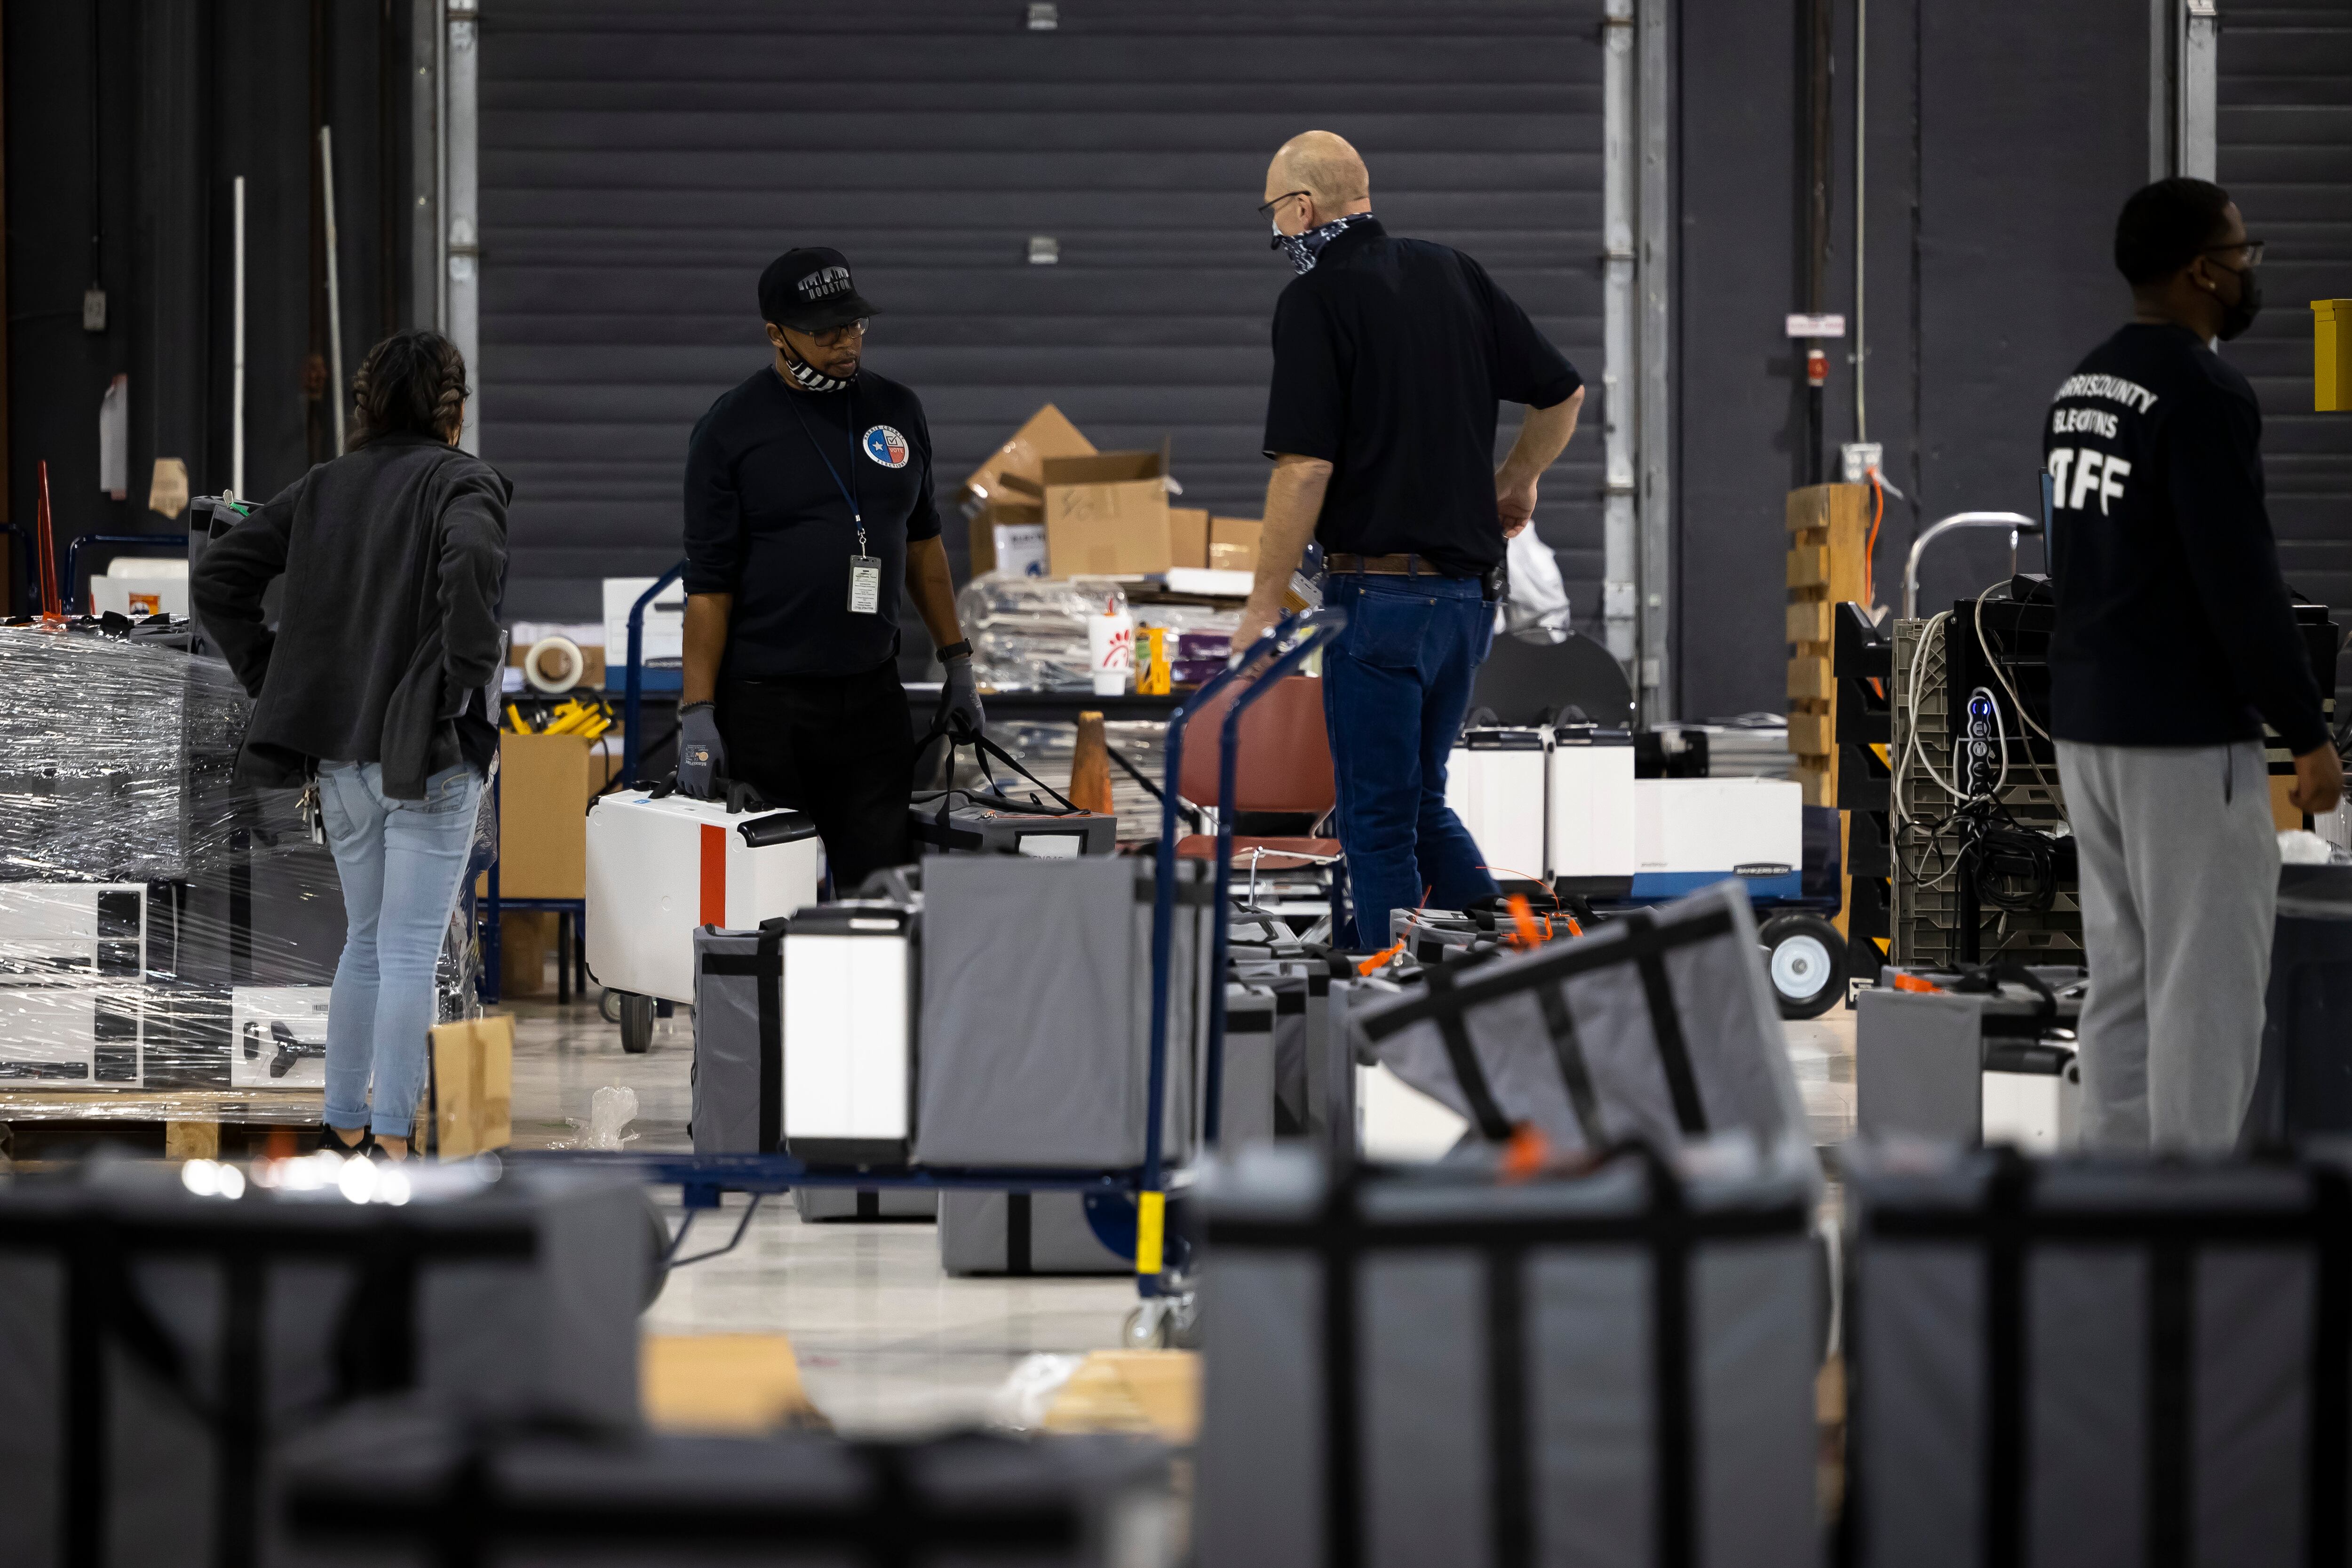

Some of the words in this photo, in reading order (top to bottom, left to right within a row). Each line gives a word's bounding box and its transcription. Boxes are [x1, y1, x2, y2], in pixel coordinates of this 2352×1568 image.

[809, 279, 851, 299] HOUSTON
[864, 425, 880, 440] HARRIS
[882, 425, 905, 440] COUNTY
[877, 459, 906, 468] ELECTIONS
